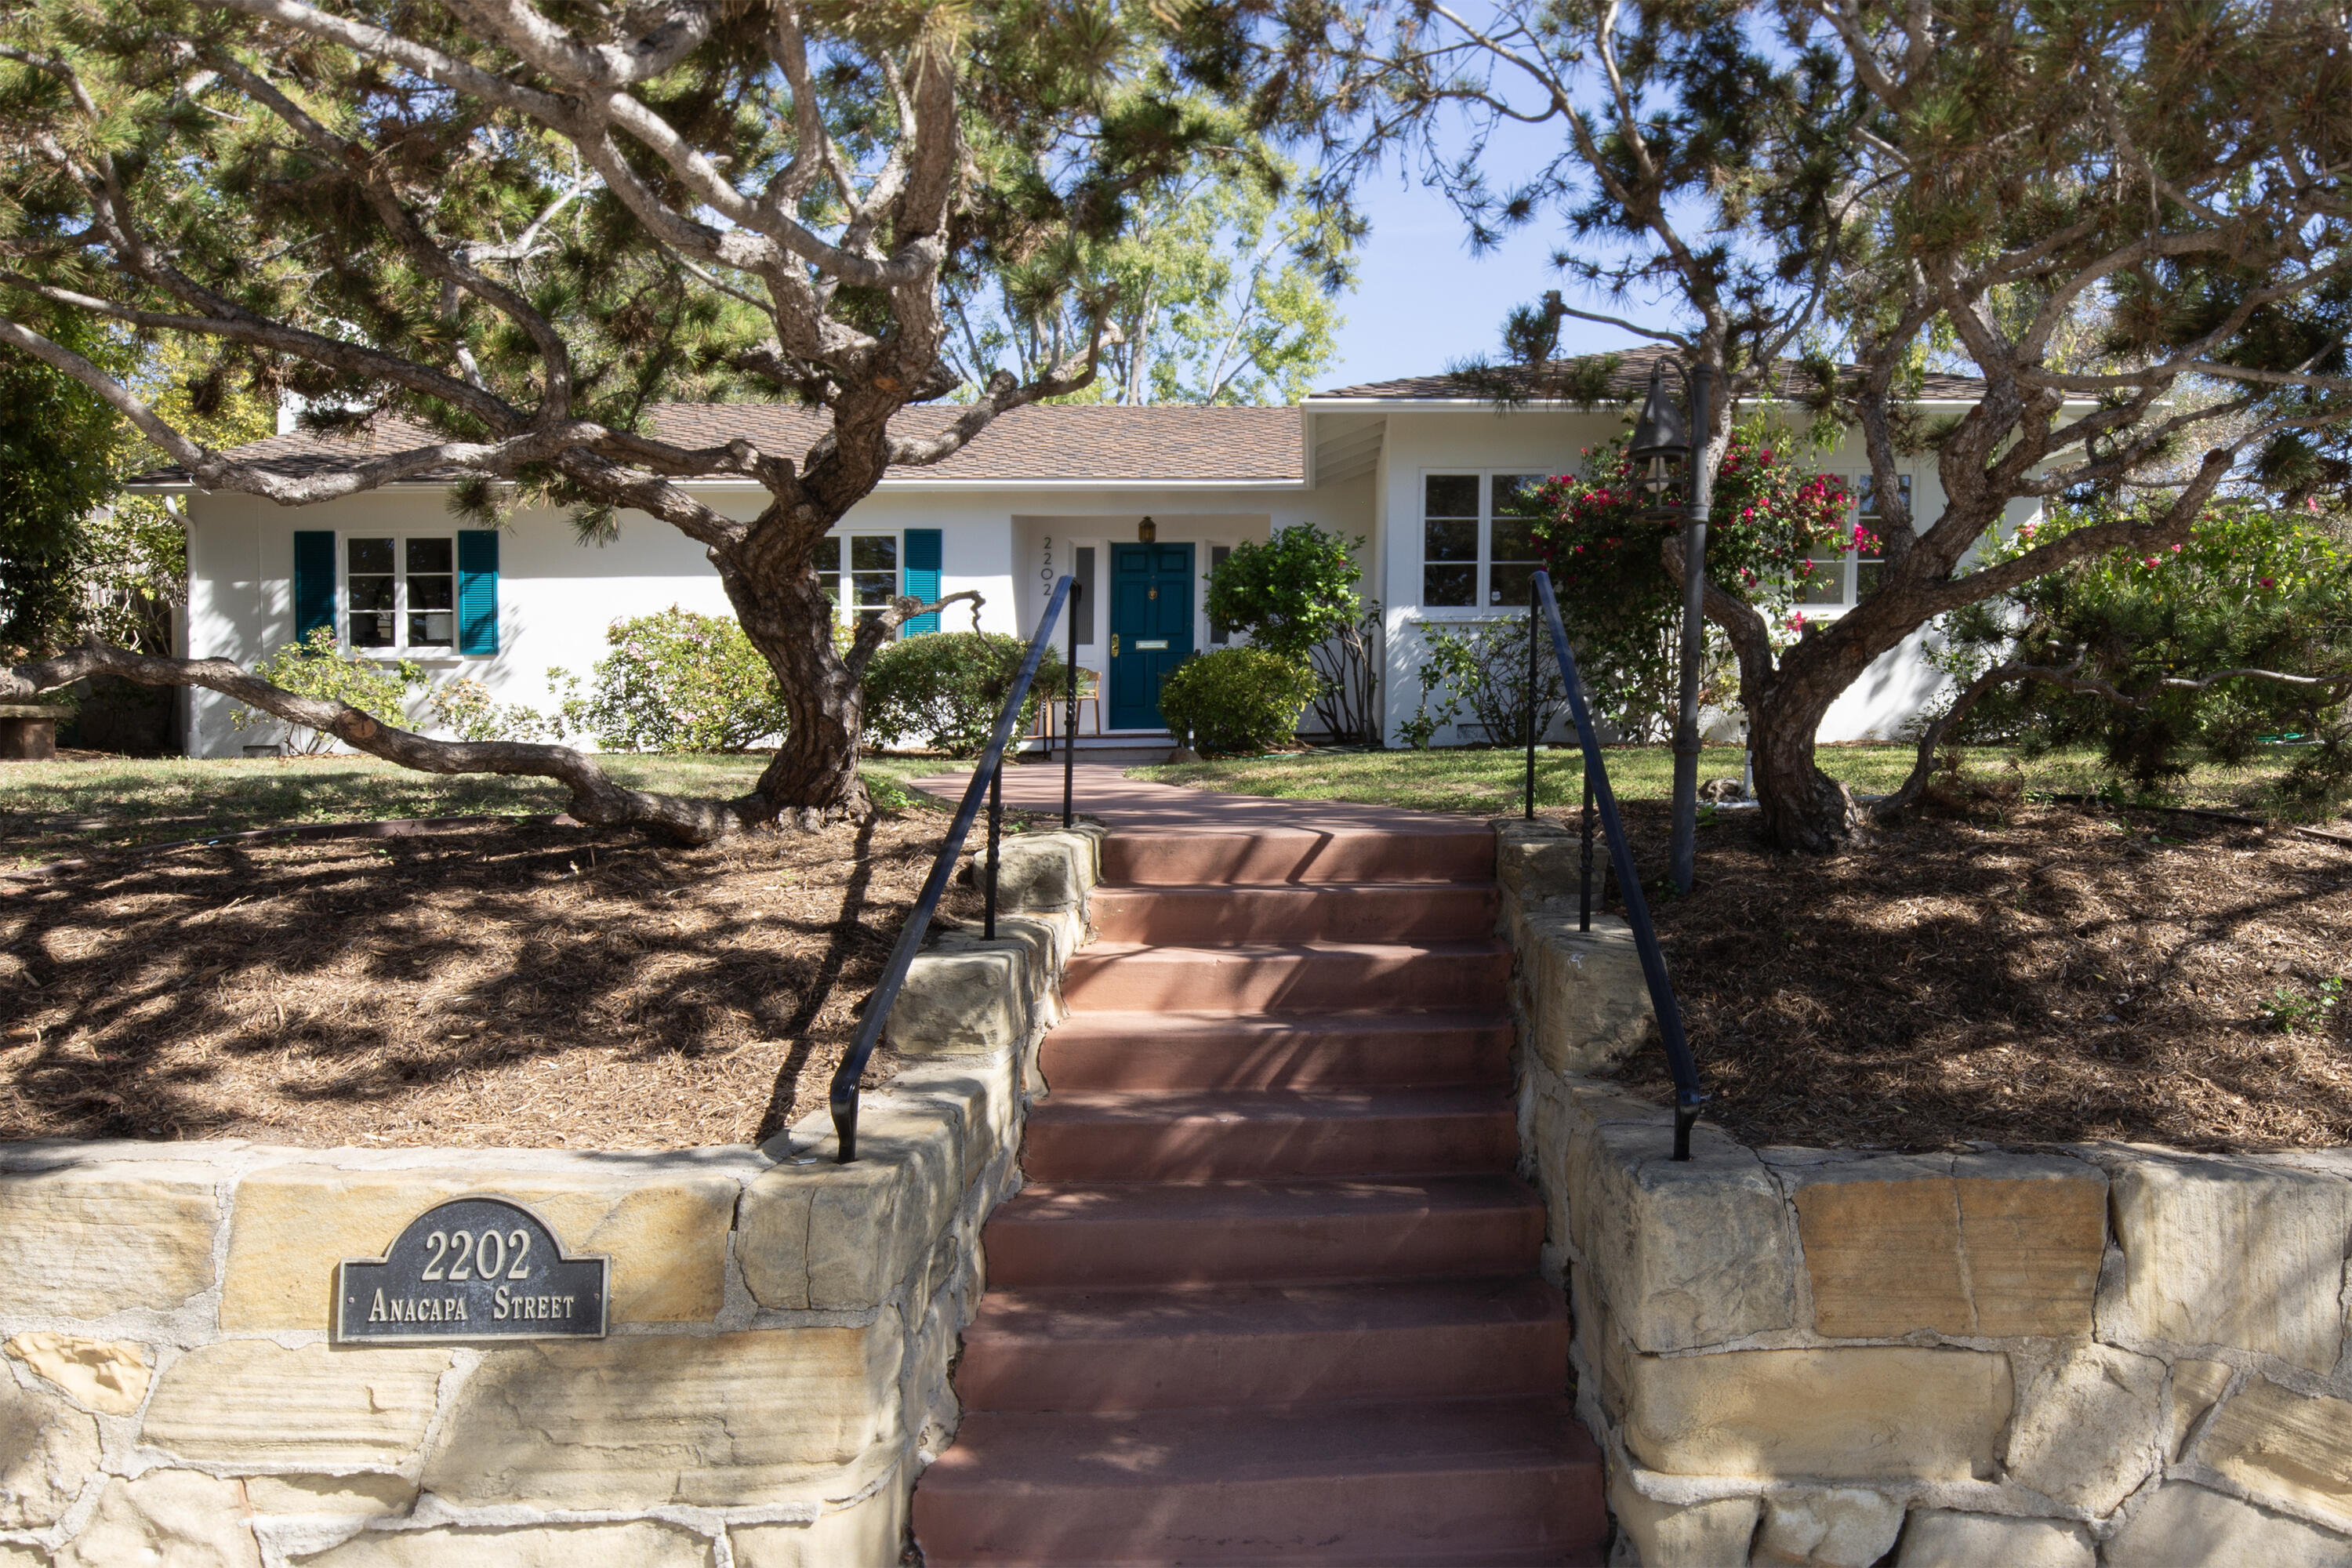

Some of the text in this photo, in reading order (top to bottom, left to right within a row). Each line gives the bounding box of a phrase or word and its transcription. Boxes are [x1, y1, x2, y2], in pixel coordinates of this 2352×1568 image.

[1041, 537, 1053, 596] 2202
[422, 1229, 531, 1281] 2202
[368, 1286, 575, 1322] ANACAPA STREET
